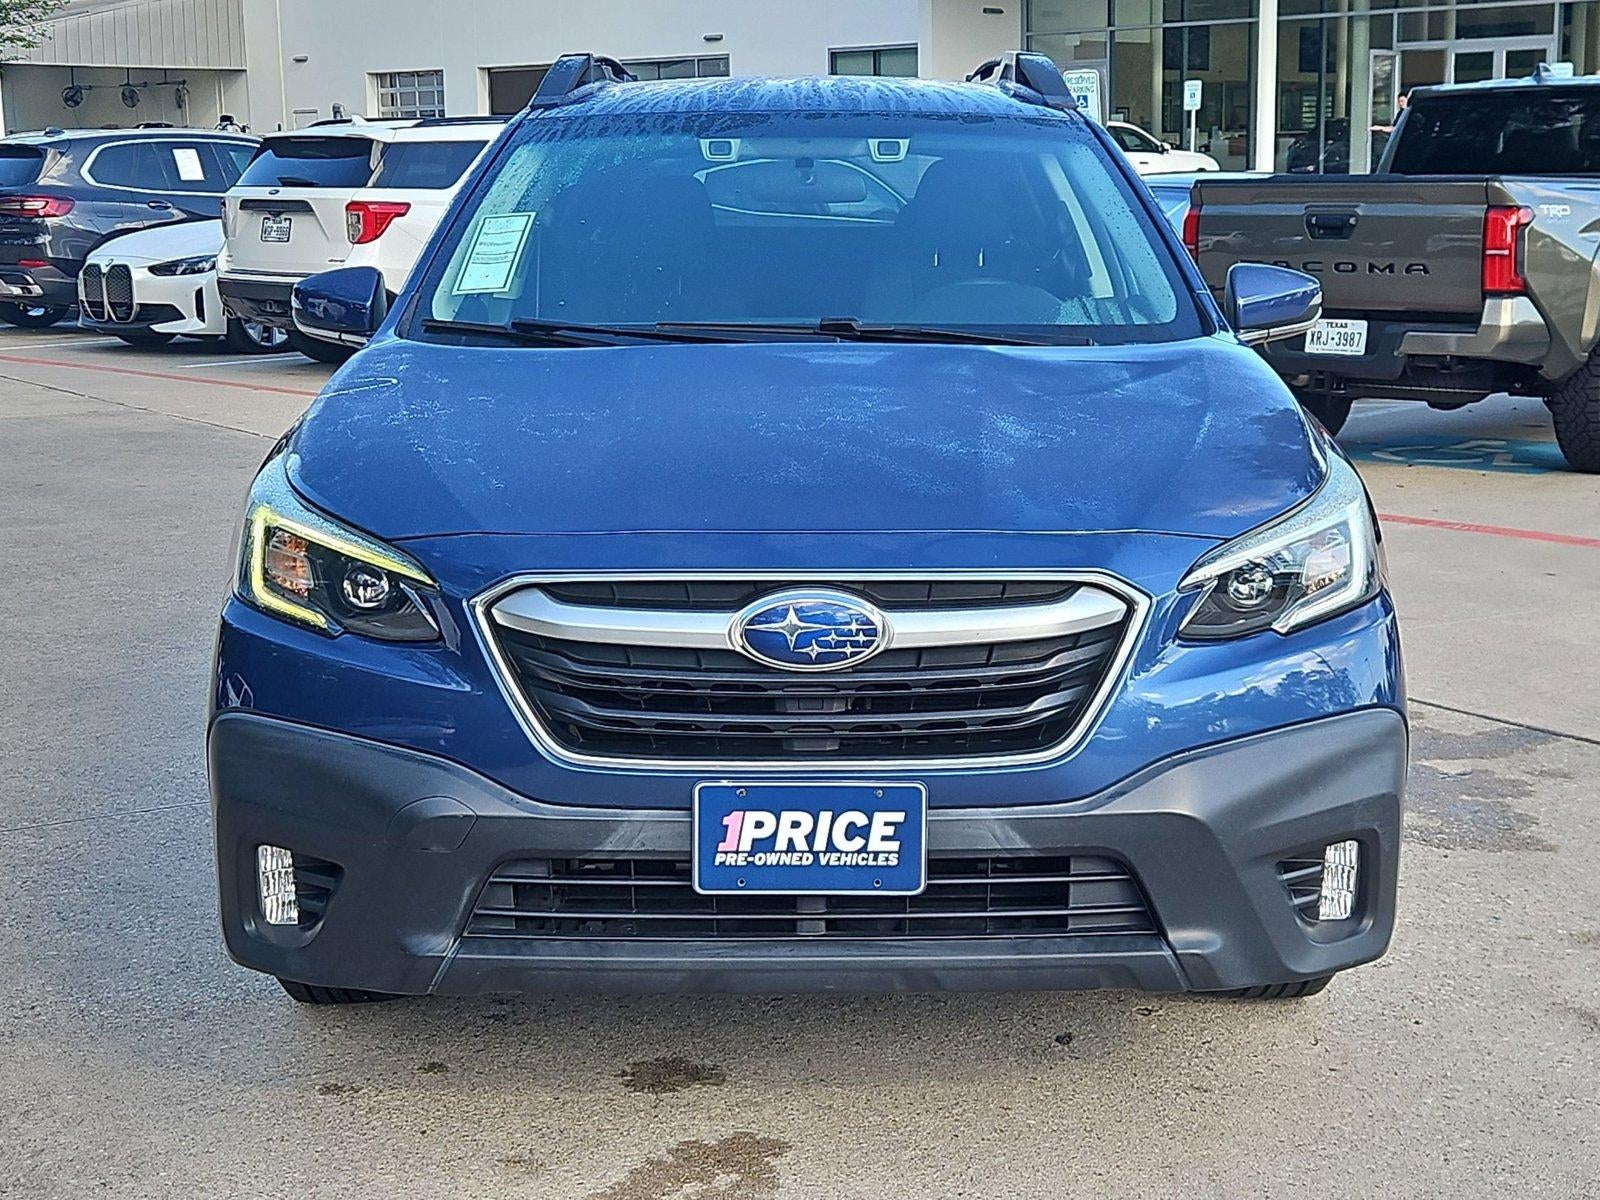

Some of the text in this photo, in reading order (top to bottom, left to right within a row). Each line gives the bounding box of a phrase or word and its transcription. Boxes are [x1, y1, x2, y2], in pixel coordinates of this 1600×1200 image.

[1066, 75, 1096, 84] RESERVED
[1539, 204, 1571, 217] TRD
[714, 852, 899, 866] PRE-OWNED VEHICLES
